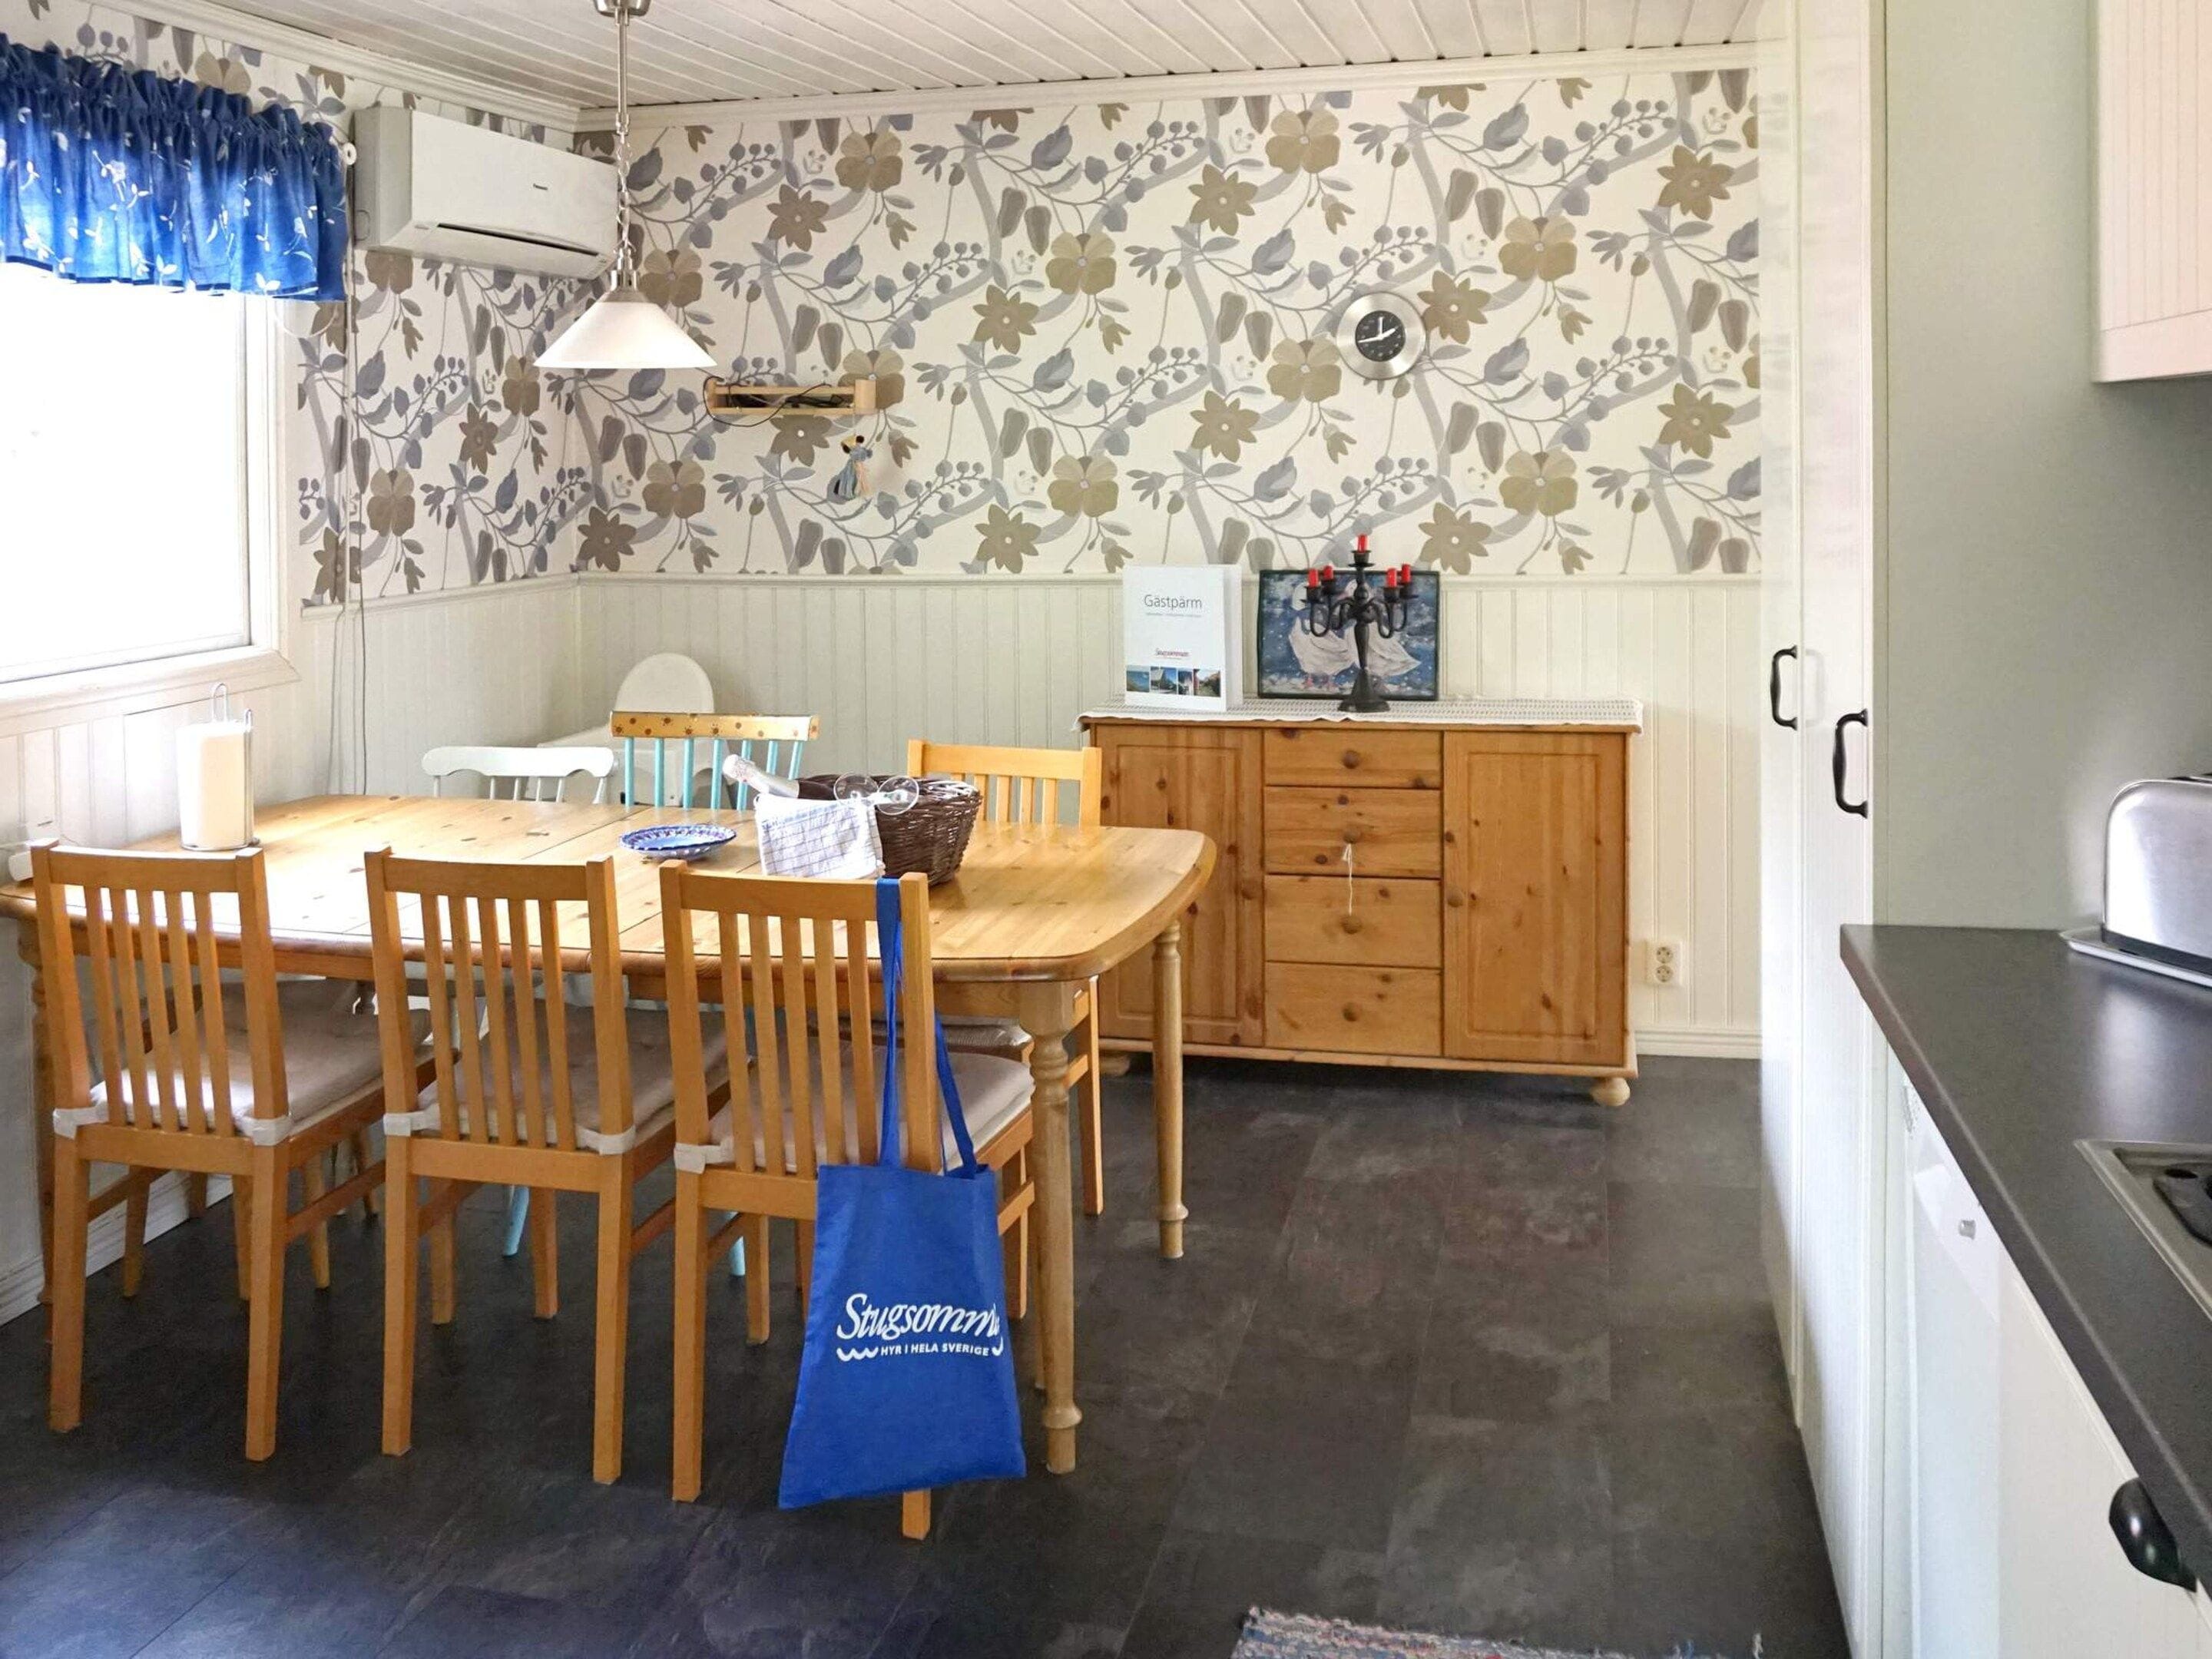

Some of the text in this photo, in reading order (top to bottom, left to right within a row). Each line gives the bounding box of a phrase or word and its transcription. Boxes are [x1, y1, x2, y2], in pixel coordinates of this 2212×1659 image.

[880, 1343, 990, 1357] HYR I HELA SVERIGE
